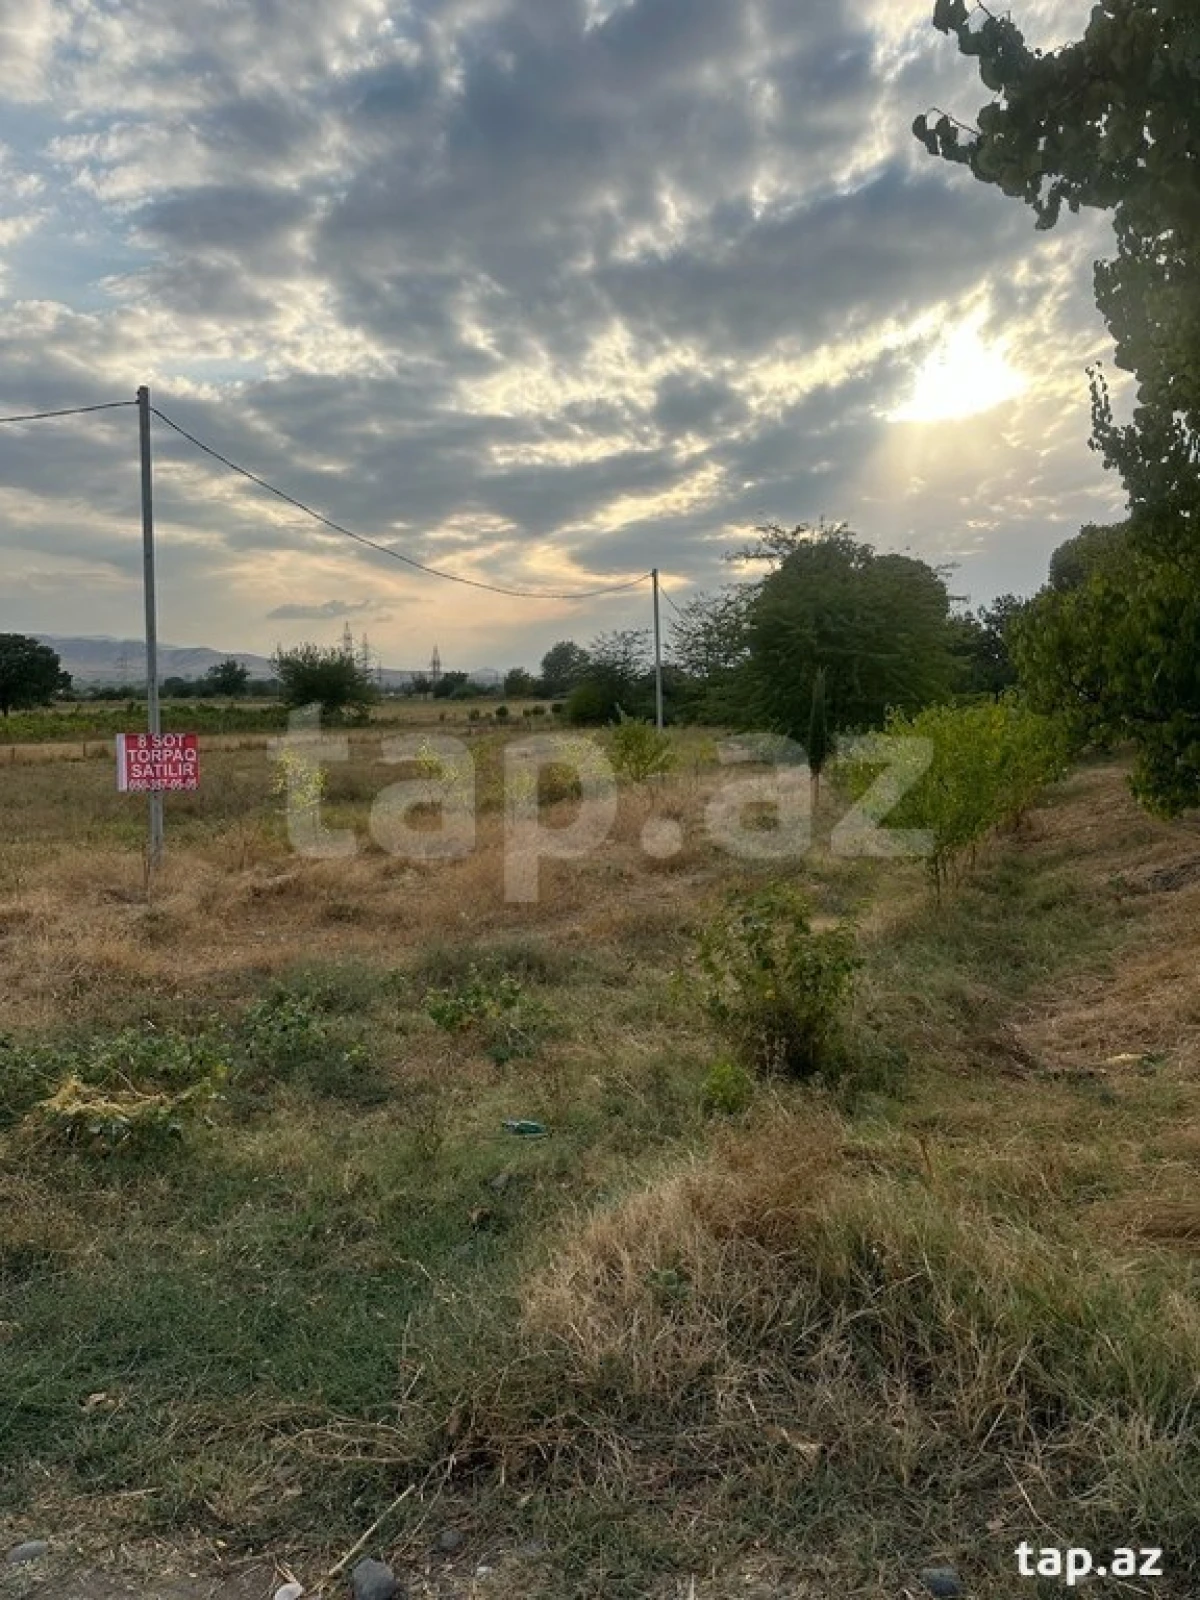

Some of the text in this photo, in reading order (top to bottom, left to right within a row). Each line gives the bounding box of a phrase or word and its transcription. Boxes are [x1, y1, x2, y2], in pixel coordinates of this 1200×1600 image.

[151, 732, 186, 747] SOT
[127, 747, 197, 763] TORPAQ
[131, 762, 195, 778] SATILIR
